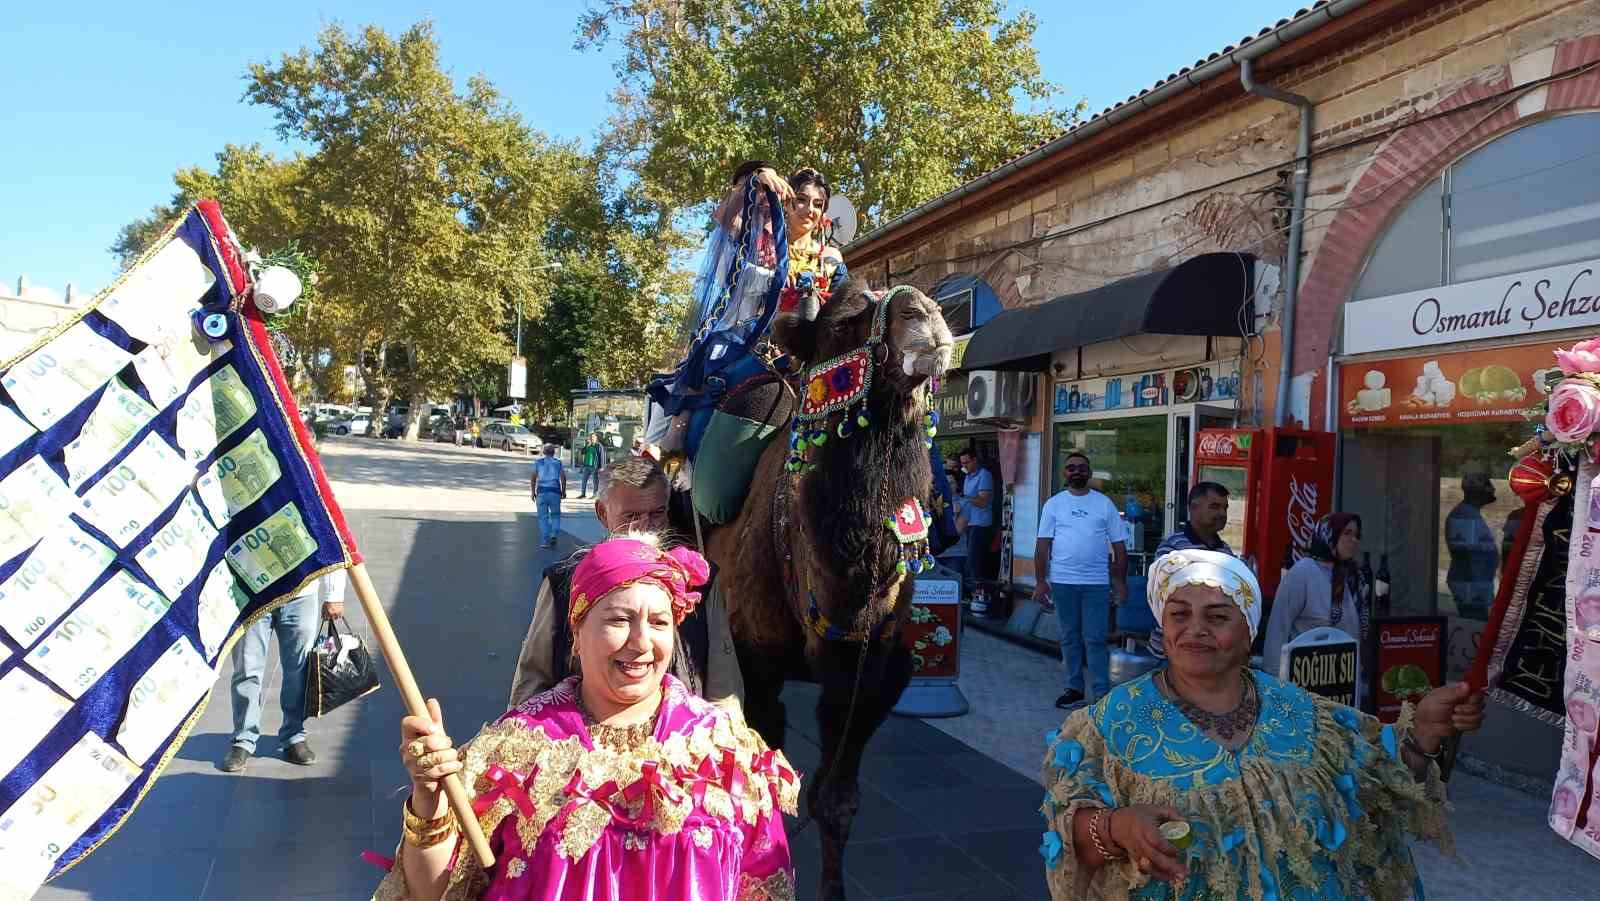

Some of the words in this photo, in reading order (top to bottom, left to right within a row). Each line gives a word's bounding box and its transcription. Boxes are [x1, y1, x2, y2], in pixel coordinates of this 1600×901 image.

[1413, 281, 1521, 335] Osmanlı
[101, 465, 136, 497] 100
[156, 523, 185, 552] 100
[242, 527, 271, 553] 100
[1580, 534, 1595, 558] 200
[14, 559, 46, 592] 100
[25, 616, 46, 636] 100
[55, 612, 93, 642] 100
[1571, 637, 1585, 662] 200
[1293, 651, 1337, 689] SOĞUK
[1340, 651, 1355, 684] SU
[130, 676, 157, 709] 100
